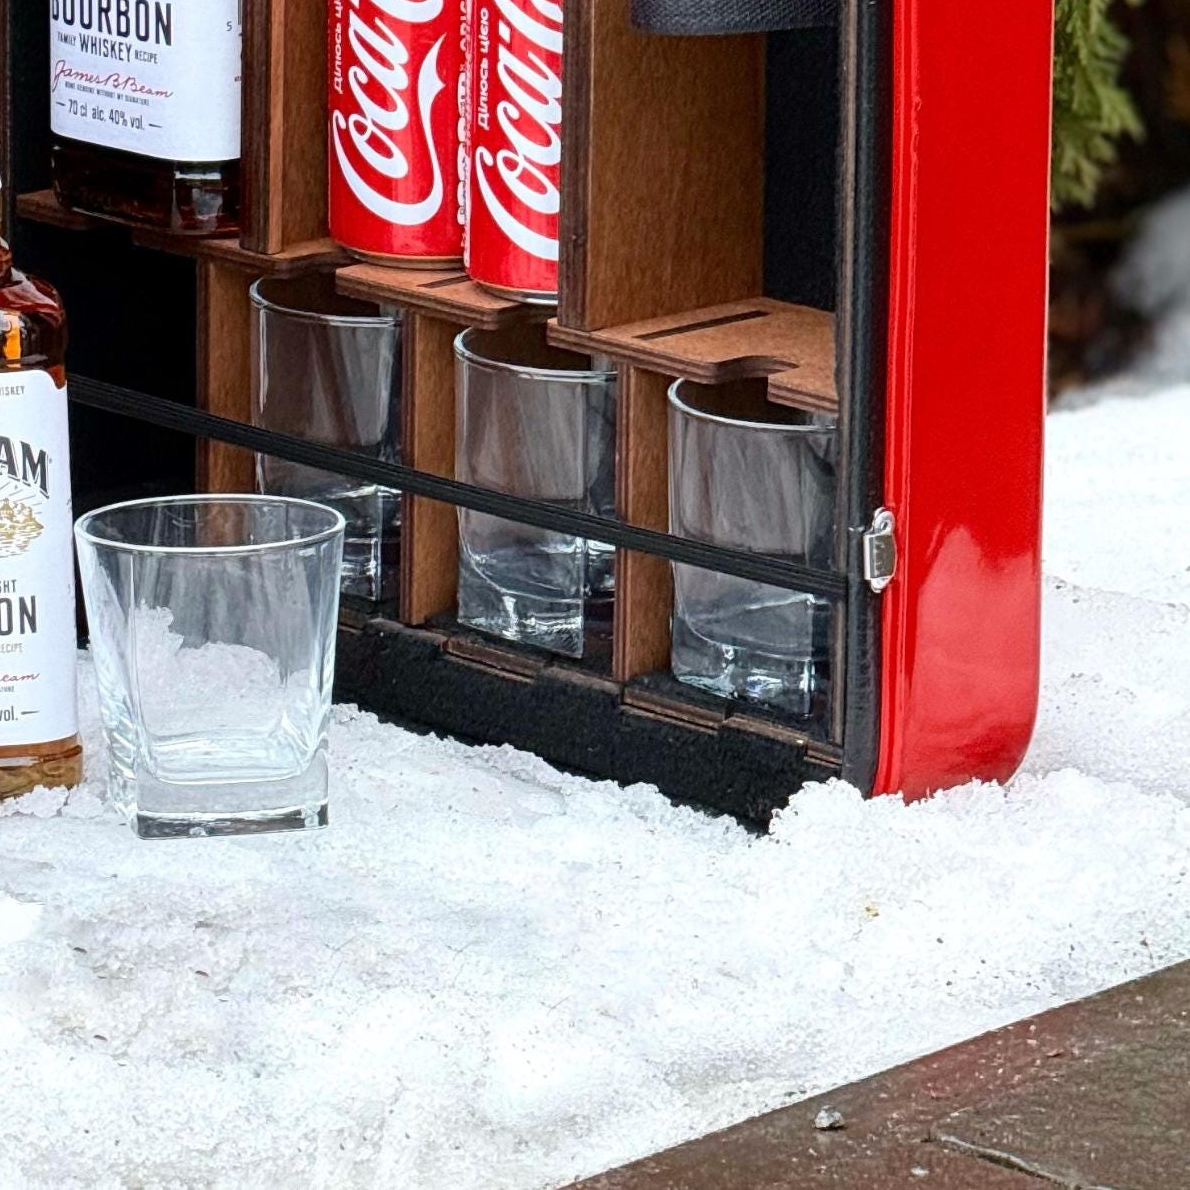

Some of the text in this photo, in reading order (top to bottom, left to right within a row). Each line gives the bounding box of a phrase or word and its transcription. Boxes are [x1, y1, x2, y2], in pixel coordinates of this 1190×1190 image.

[79, 32, 132, 63] WHISKEY
[477, 57, 490, 131] Ділюсь
[68, 99, 146, 131] 70 cl alc. 40% vol.
